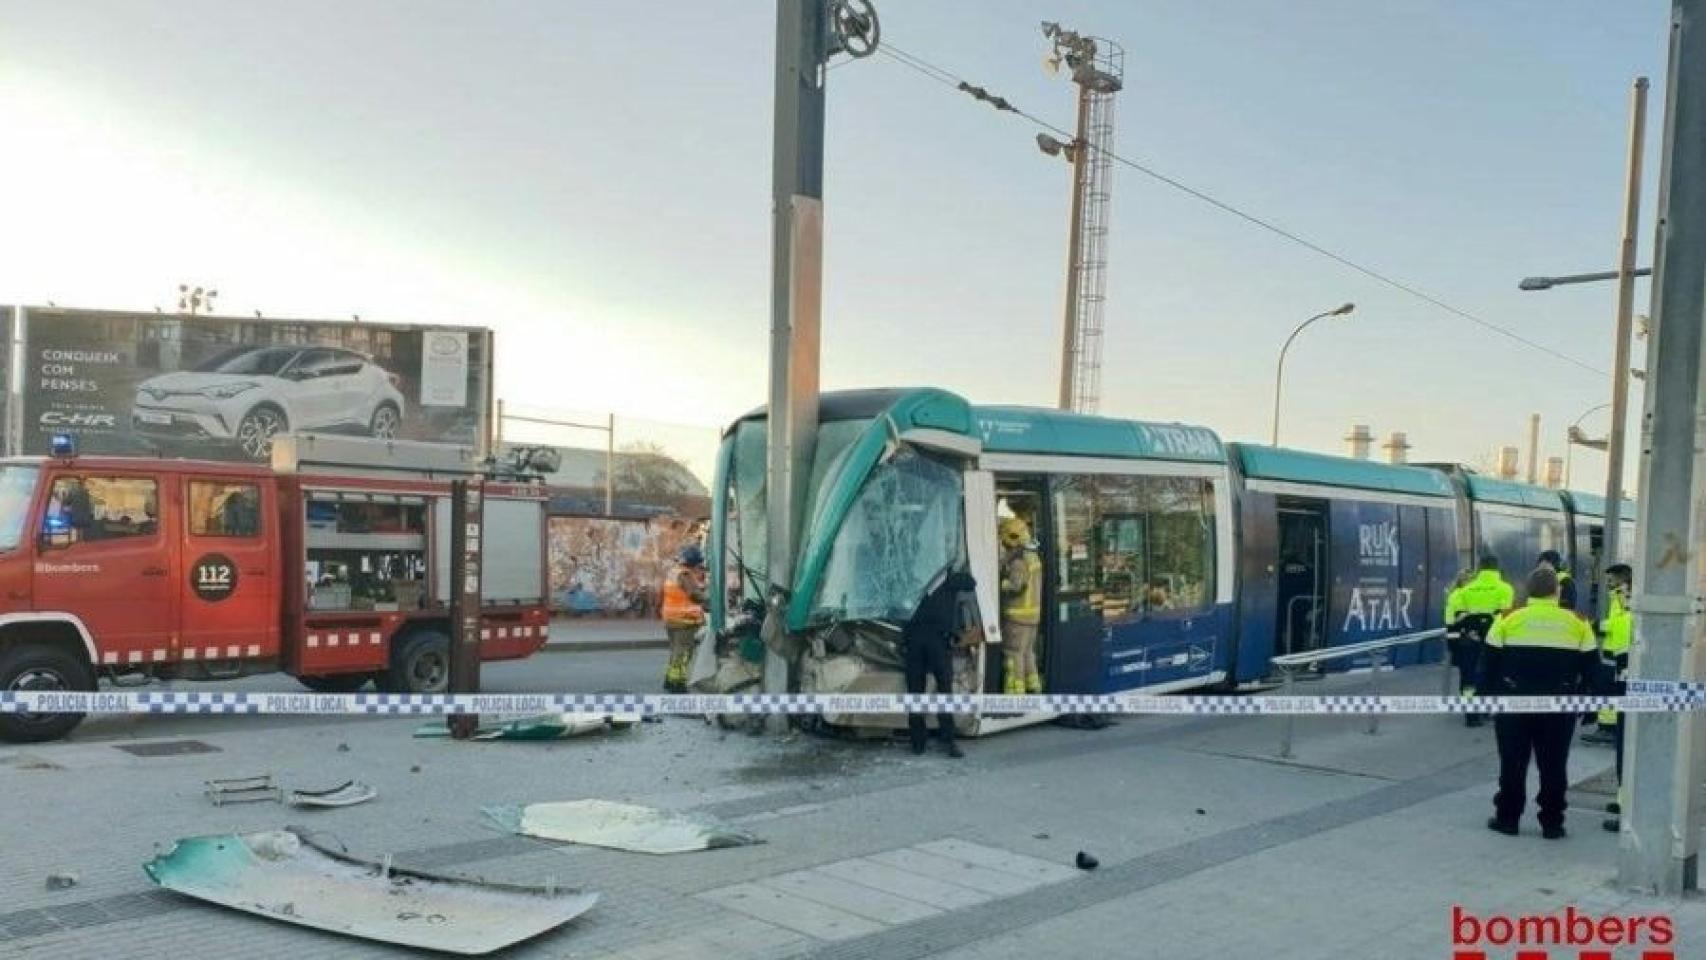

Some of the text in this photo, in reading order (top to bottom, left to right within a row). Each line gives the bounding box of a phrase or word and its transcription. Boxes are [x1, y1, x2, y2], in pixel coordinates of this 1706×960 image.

[42, 364, 74, 376] COM
[41, 379, 98, 392] PENSES
[40, 412, 115, 426] C-HR
[44, 562, 99, 573] bombers
[199, 565, 230, 583] 112
[1343, 587, 1413, 632] ATAR
[38, 694, 130, 711] POLICIA LOCAL
[267, 696, 349, 711] POLICIA LOCAL
